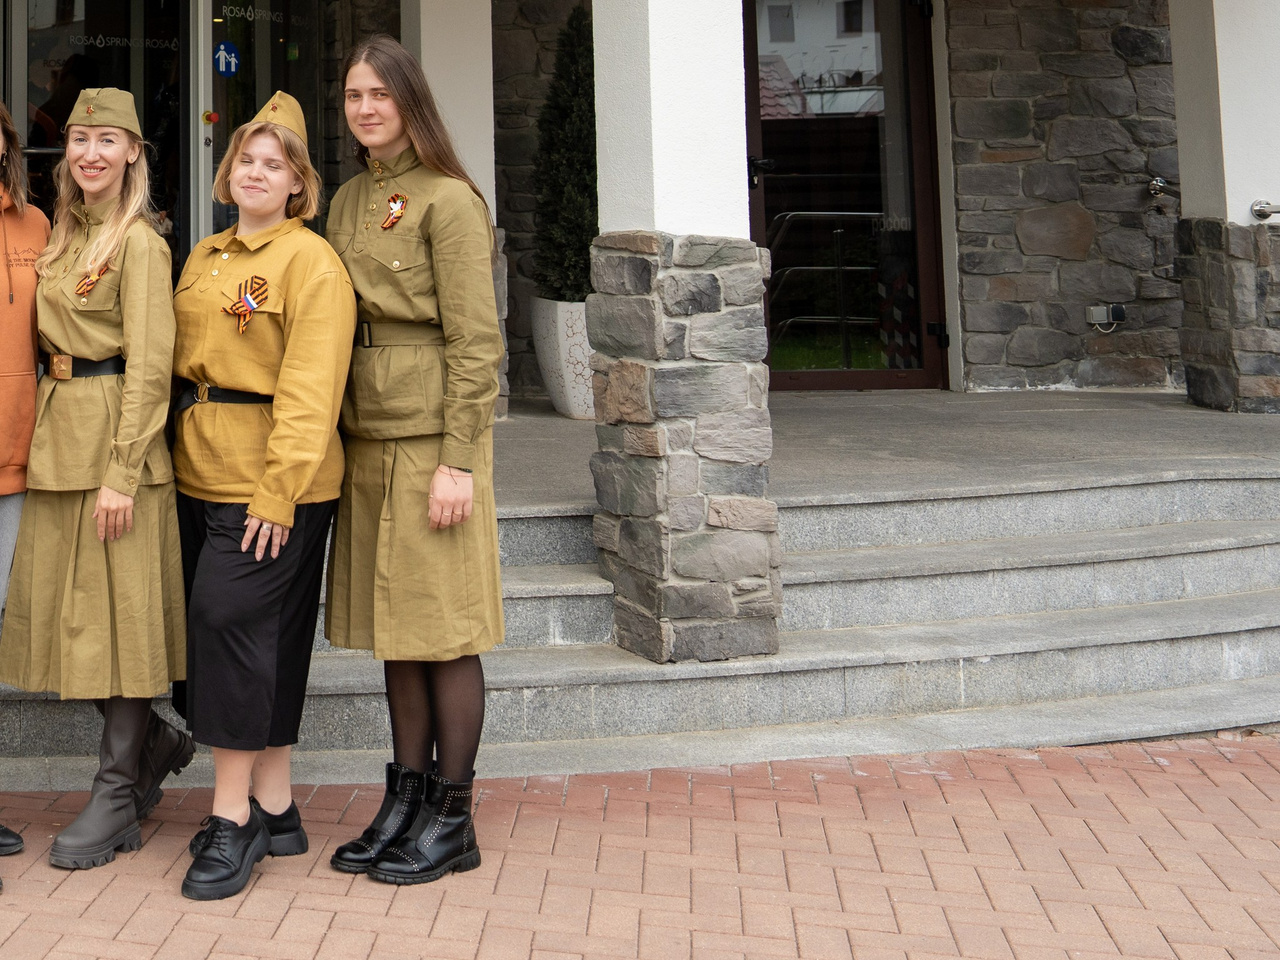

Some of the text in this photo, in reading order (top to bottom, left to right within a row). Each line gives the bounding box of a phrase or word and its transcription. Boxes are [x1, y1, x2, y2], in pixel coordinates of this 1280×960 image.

[223, 5, 284, 23] ROSA SPRINGS
[70, 35, 170, 49] ROSA SPRINGS ROSA
